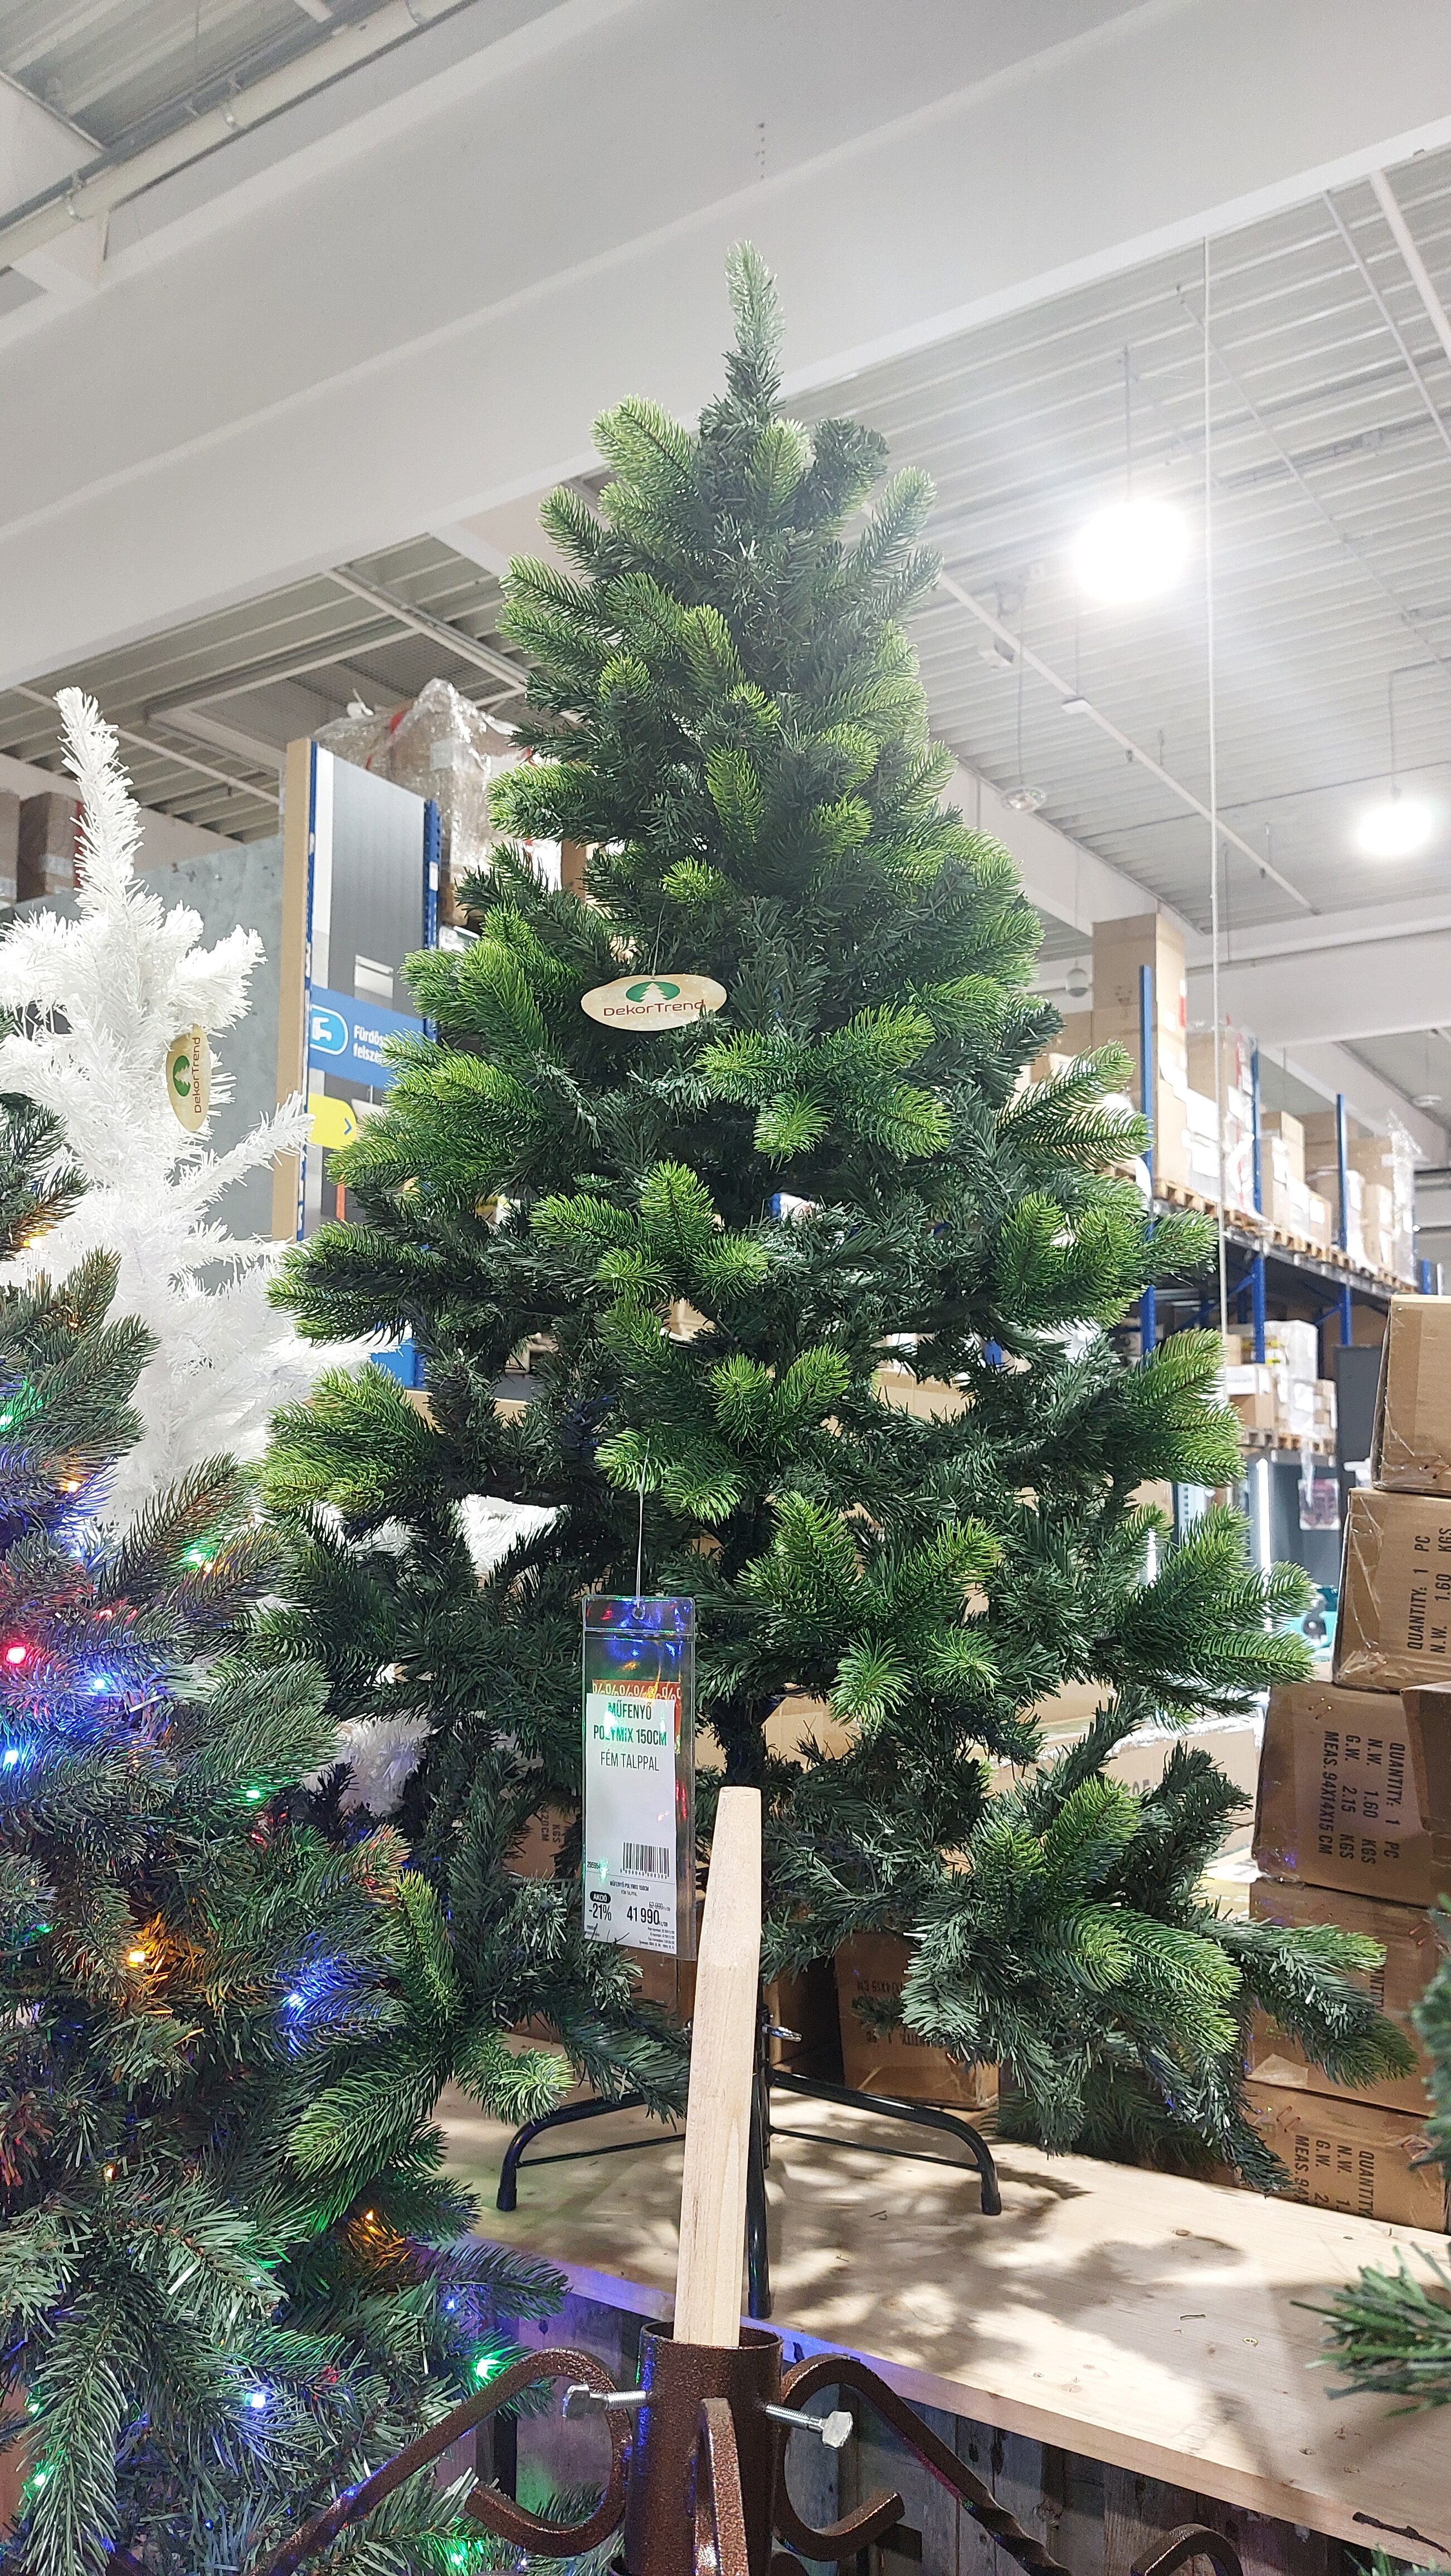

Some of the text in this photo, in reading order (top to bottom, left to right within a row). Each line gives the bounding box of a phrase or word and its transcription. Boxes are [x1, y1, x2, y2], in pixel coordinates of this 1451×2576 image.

[603, 999, 704, 1016] DekorTrend
[192, 1037, 202, 1113] DekorTrend
[1414, 1535, 1430, 1552] PC
[1435, 1573, 1451, 1601] 1.60
[1407, 1587, 1428, 1650] QUANTITY:
[1430, 1626, 1447, 1653] N.W.
[608, 1700, 652, 1720] MŰFENYŐ
[636, 1729, 667, 1746] 150CM
[601, 1749, 660, 1772] FÉM TALPPAL
[1385, 1742, 1406, 1807] QUANTITY:
[1339, 1734, 1361, 1860] G.W. 2.15 KGS
[1361, 1738, 1383, 1864] N.W. 1.60 KGS
[552, 1824, 561, 1843] KGS
[1318, 1835, 1333, 1855] CM
[1383, 1840, 1400, 1858] PC
[593, 1892, 607, 1902] AKCIÓ
[588, 1903, 612, 1921] -21%
[1316, 2140, 1331, 2167] G.W.
[1336, 2145, 1352, 2174] N.W.
